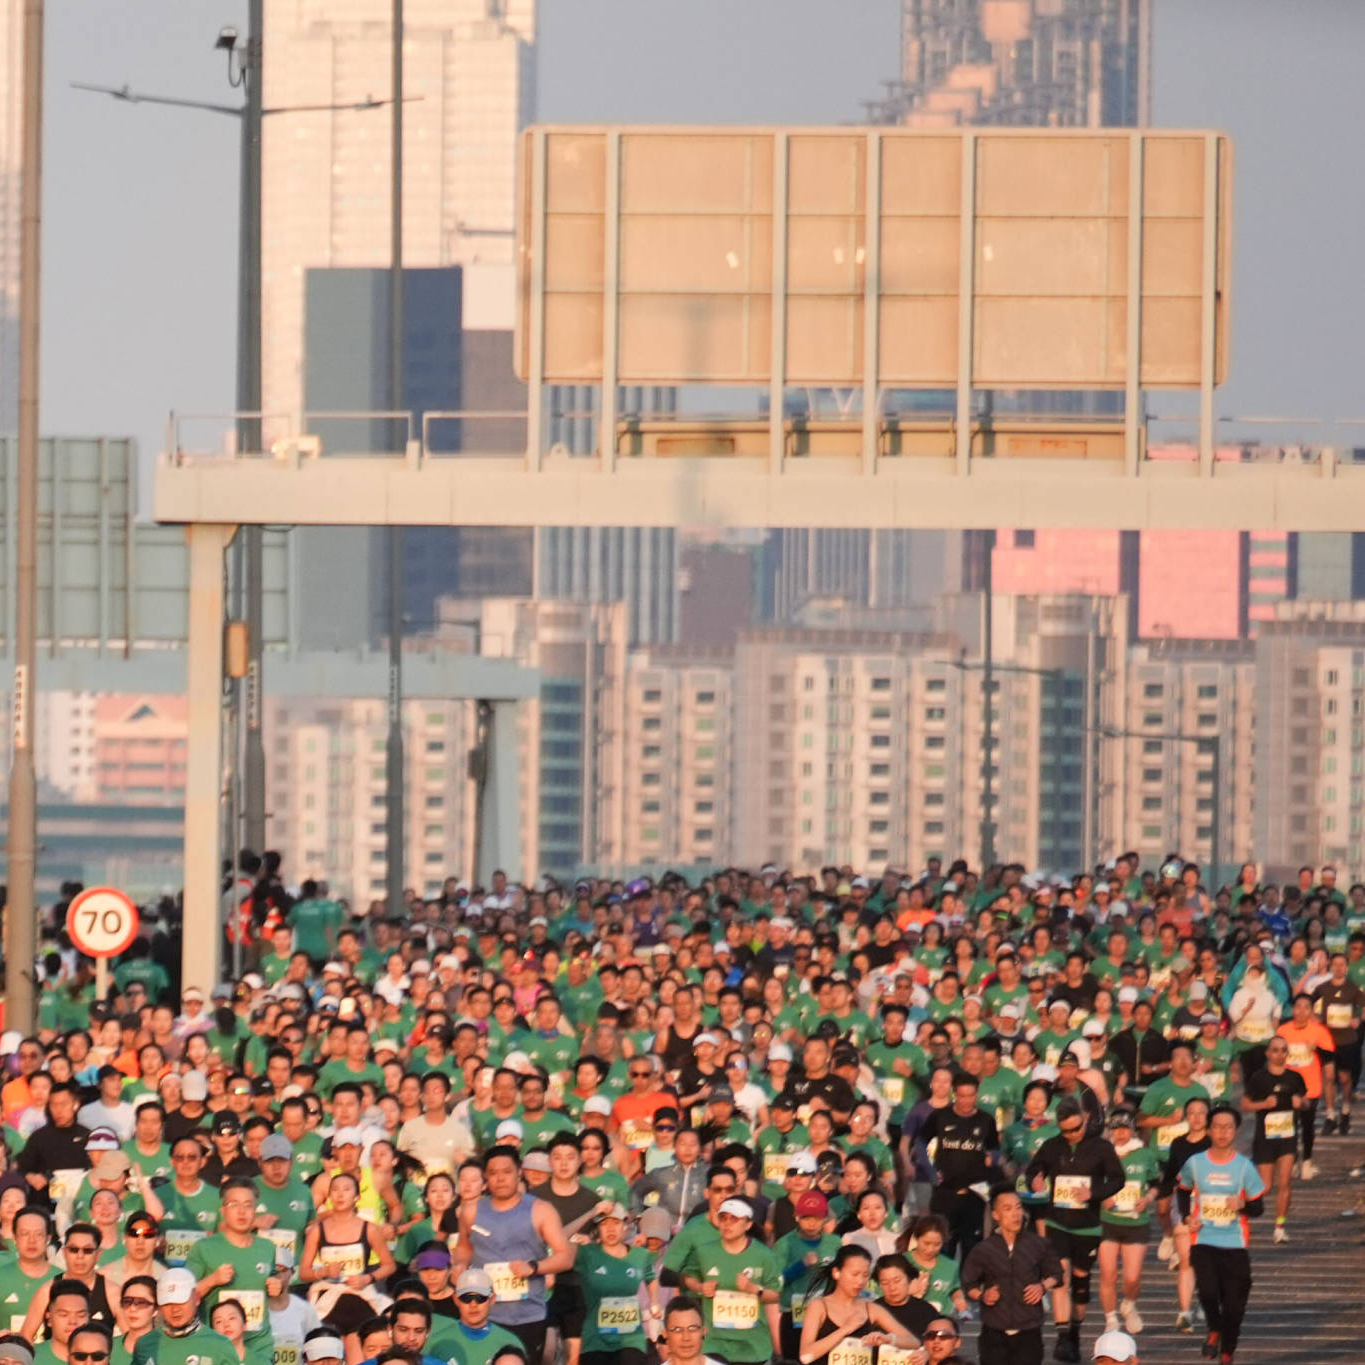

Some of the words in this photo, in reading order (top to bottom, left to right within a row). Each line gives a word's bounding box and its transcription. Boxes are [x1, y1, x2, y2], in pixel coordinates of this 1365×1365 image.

[82, 910, 121, 935] 70
[495, 1275, 525, 1289] 1784
[601, 1311, 638, 1323] P2522
[717, 1305, 756, 1318] P1150
[273, 1348, 296, 1363] 009
